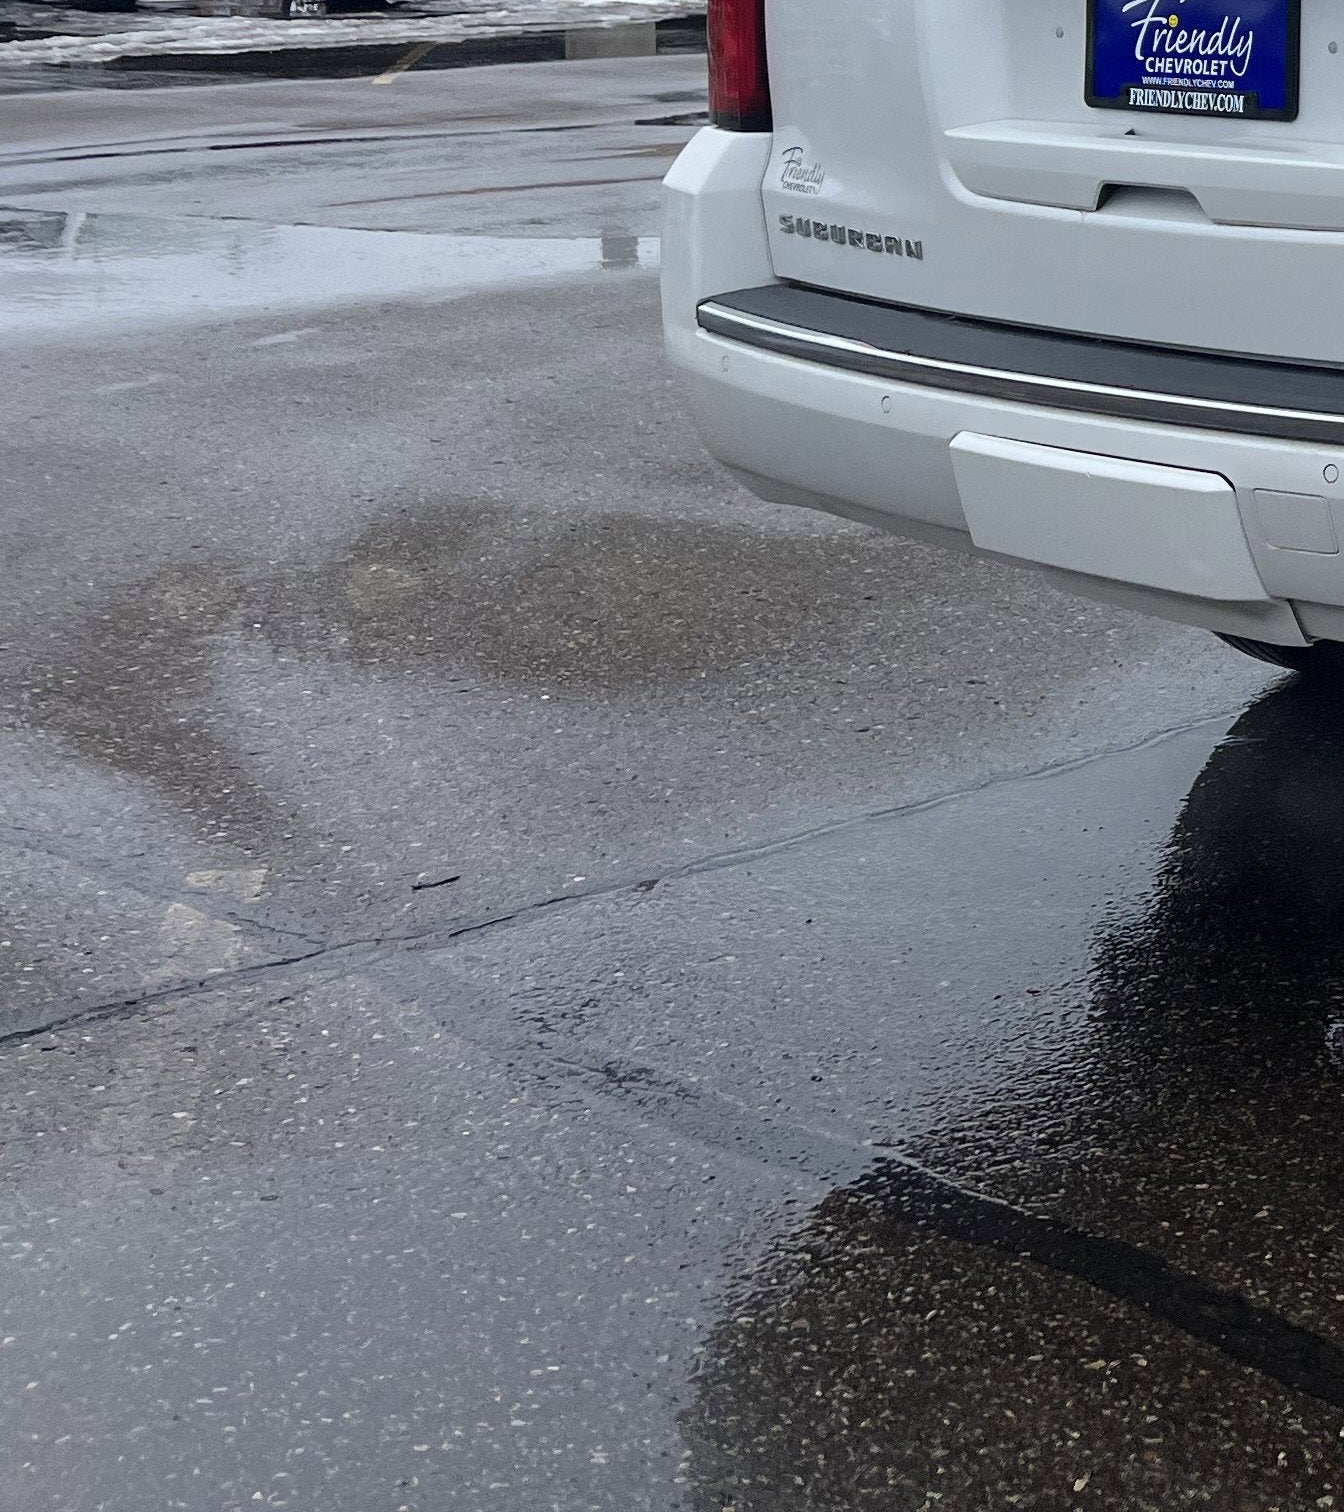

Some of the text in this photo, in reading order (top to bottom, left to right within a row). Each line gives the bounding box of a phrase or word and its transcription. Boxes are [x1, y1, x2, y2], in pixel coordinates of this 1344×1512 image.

[1145, 56, 1228, 76] CHEVROLET
[1128, 87, 1244, 113] FRIENDLYCHEV.COM
[779, 215, 923, 260] SUBURBAN
